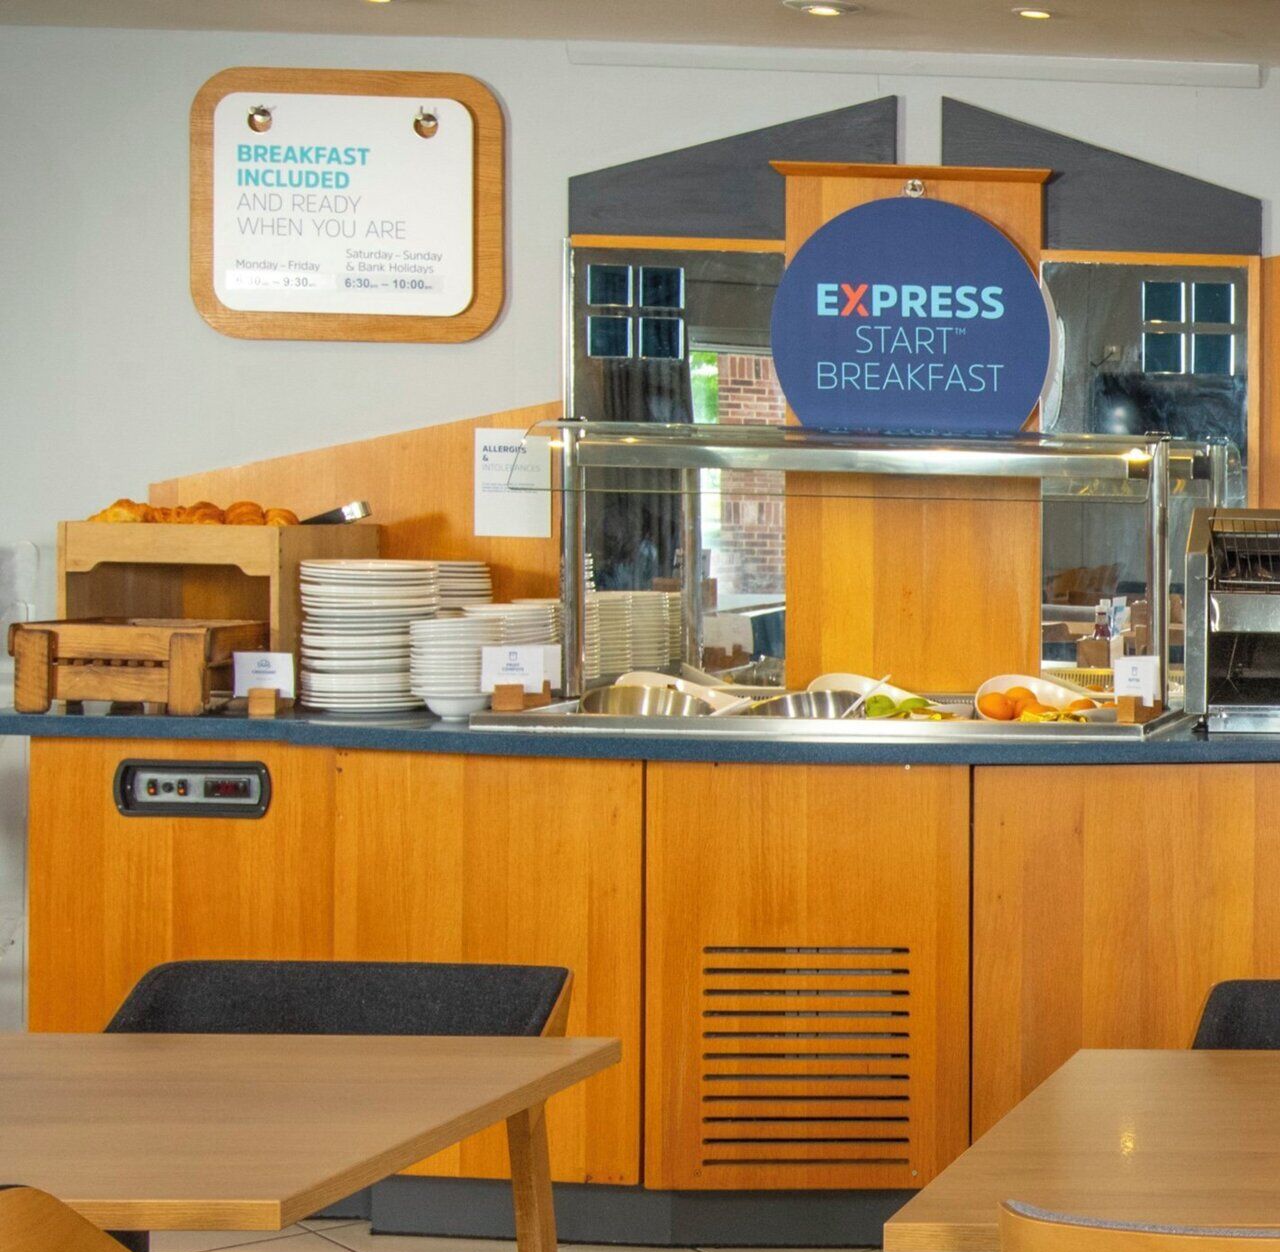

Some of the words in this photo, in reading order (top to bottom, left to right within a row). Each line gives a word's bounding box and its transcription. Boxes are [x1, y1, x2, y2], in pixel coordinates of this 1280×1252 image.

[236, 144, 370, 166] BREAKFAST
[236, 169, 350, 189] INCLUDED
[236, 193, 283, 212] AND
[291, 194, 362, 214] READY
[236, 217, 303, 237] WHEN
[312, 219, 357, 239] YOU
[364, 220, 406, 240] ARE
[345, 248, 394, 261] Saturday
[402, 249, 444, 262] Sunday
[235, 259, 279, 270] Monday
[288, 260, 321, 272] Friday
[345, 262, 355, 271] &
[358, 261, 385, 272] Bank
[389, 262, 435, 274] Holidays
[816, 282, 1005, 320] EXPRESS
[816, 361, 1005, 393] BREAKFAST
[482, 454, 489, 462] &
